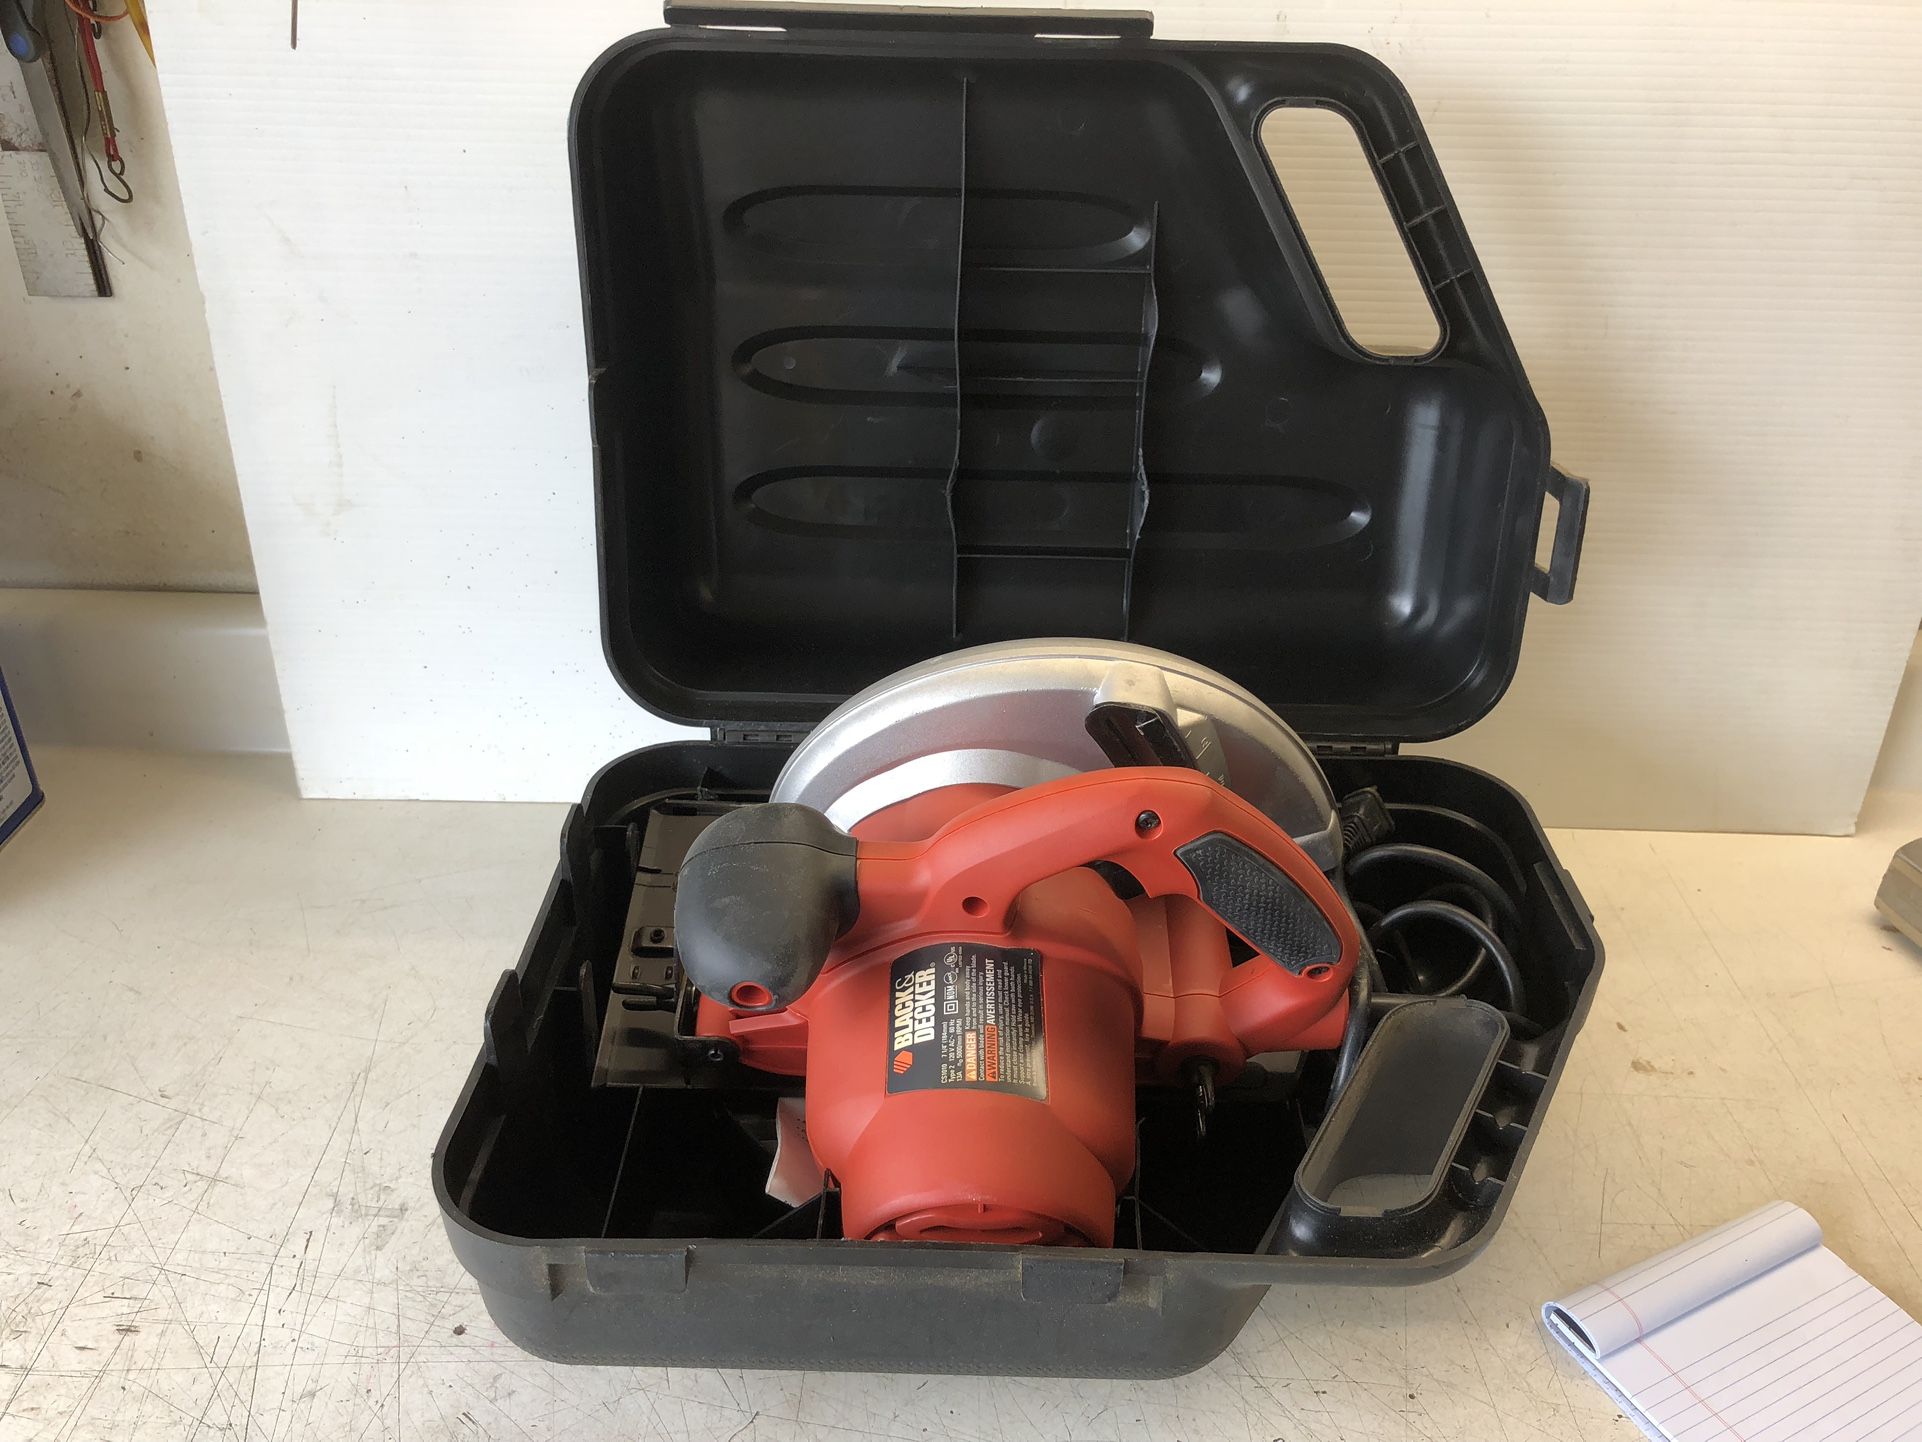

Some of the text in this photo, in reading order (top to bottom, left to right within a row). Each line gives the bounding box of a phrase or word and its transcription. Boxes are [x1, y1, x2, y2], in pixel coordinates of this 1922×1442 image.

[985, 958, 996, 1024] AVERTISSEMENT
[966, 1032, 976, 1070] DANGER
[986, 1027, 996, 1070] WARNING
